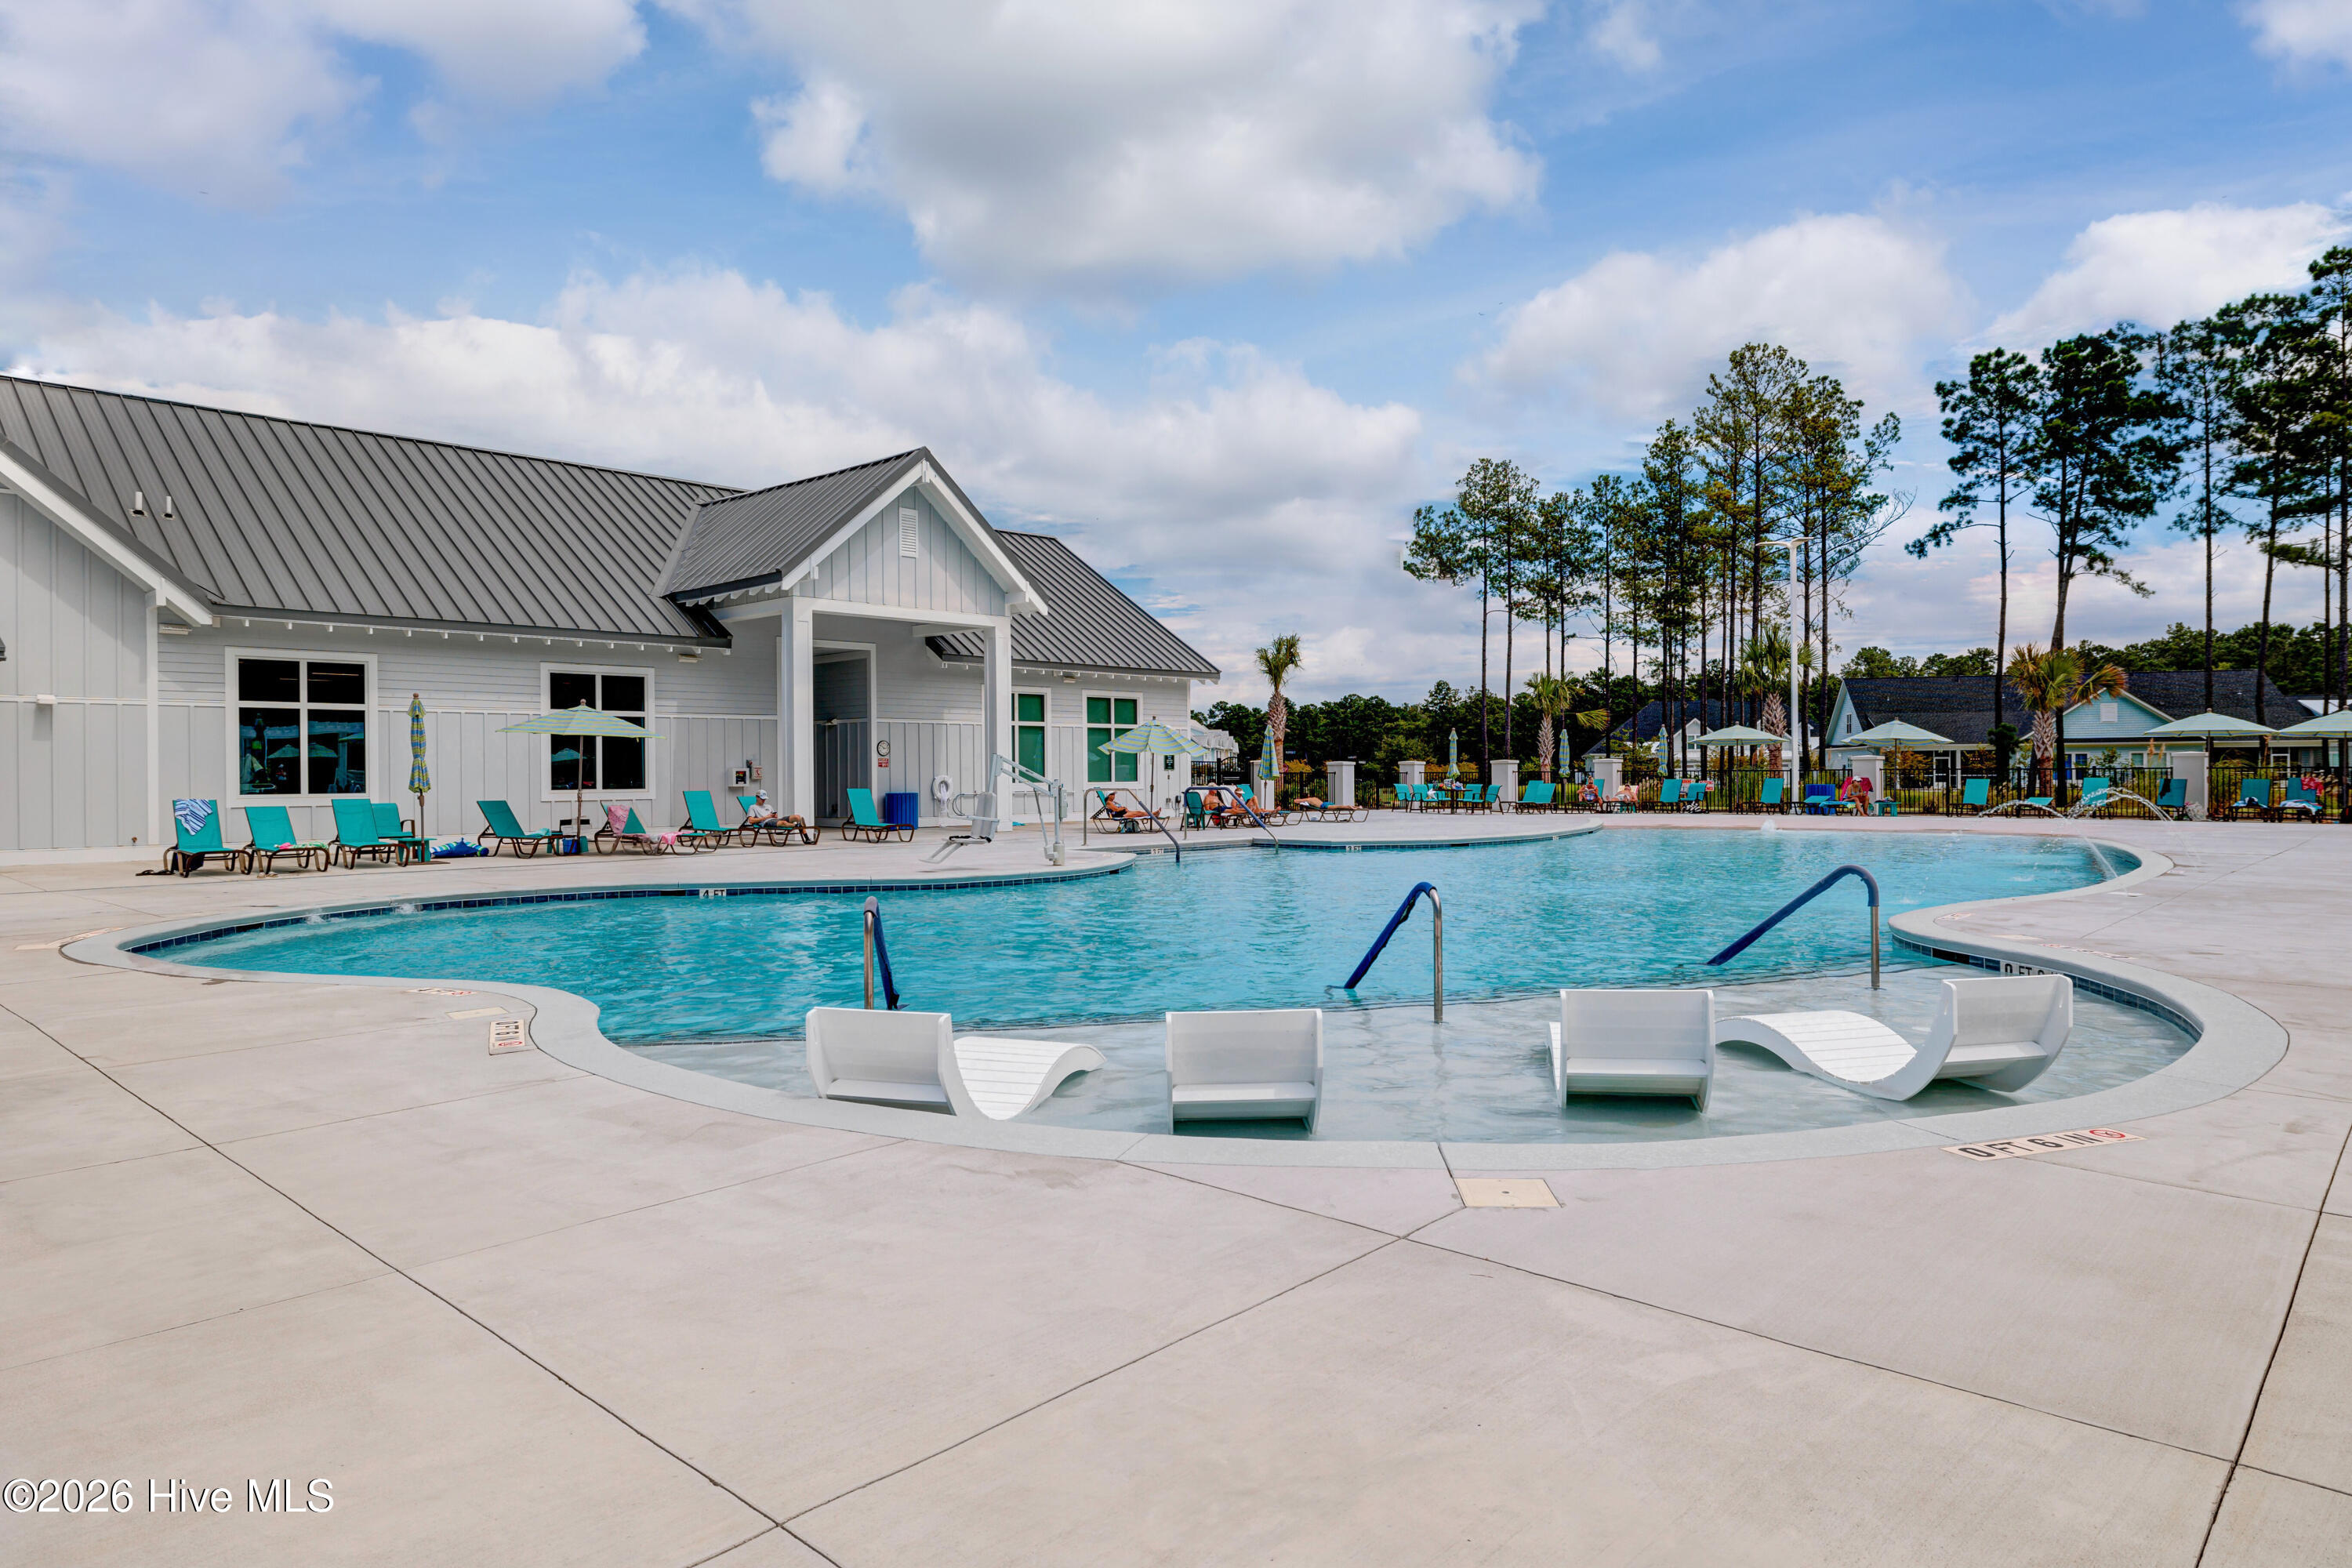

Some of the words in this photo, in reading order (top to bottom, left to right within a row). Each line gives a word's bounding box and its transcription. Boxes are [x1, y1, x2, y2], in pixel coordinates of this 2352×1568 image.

[2019, 965, 2032, 975] FT
[1958, 1147, 1996, 1157] 0
[1985, 1142, 2034, 1154] FT
[2027, 1138, 2064, 1148] 6
[2054, 1133, 2103, 1145] IN
